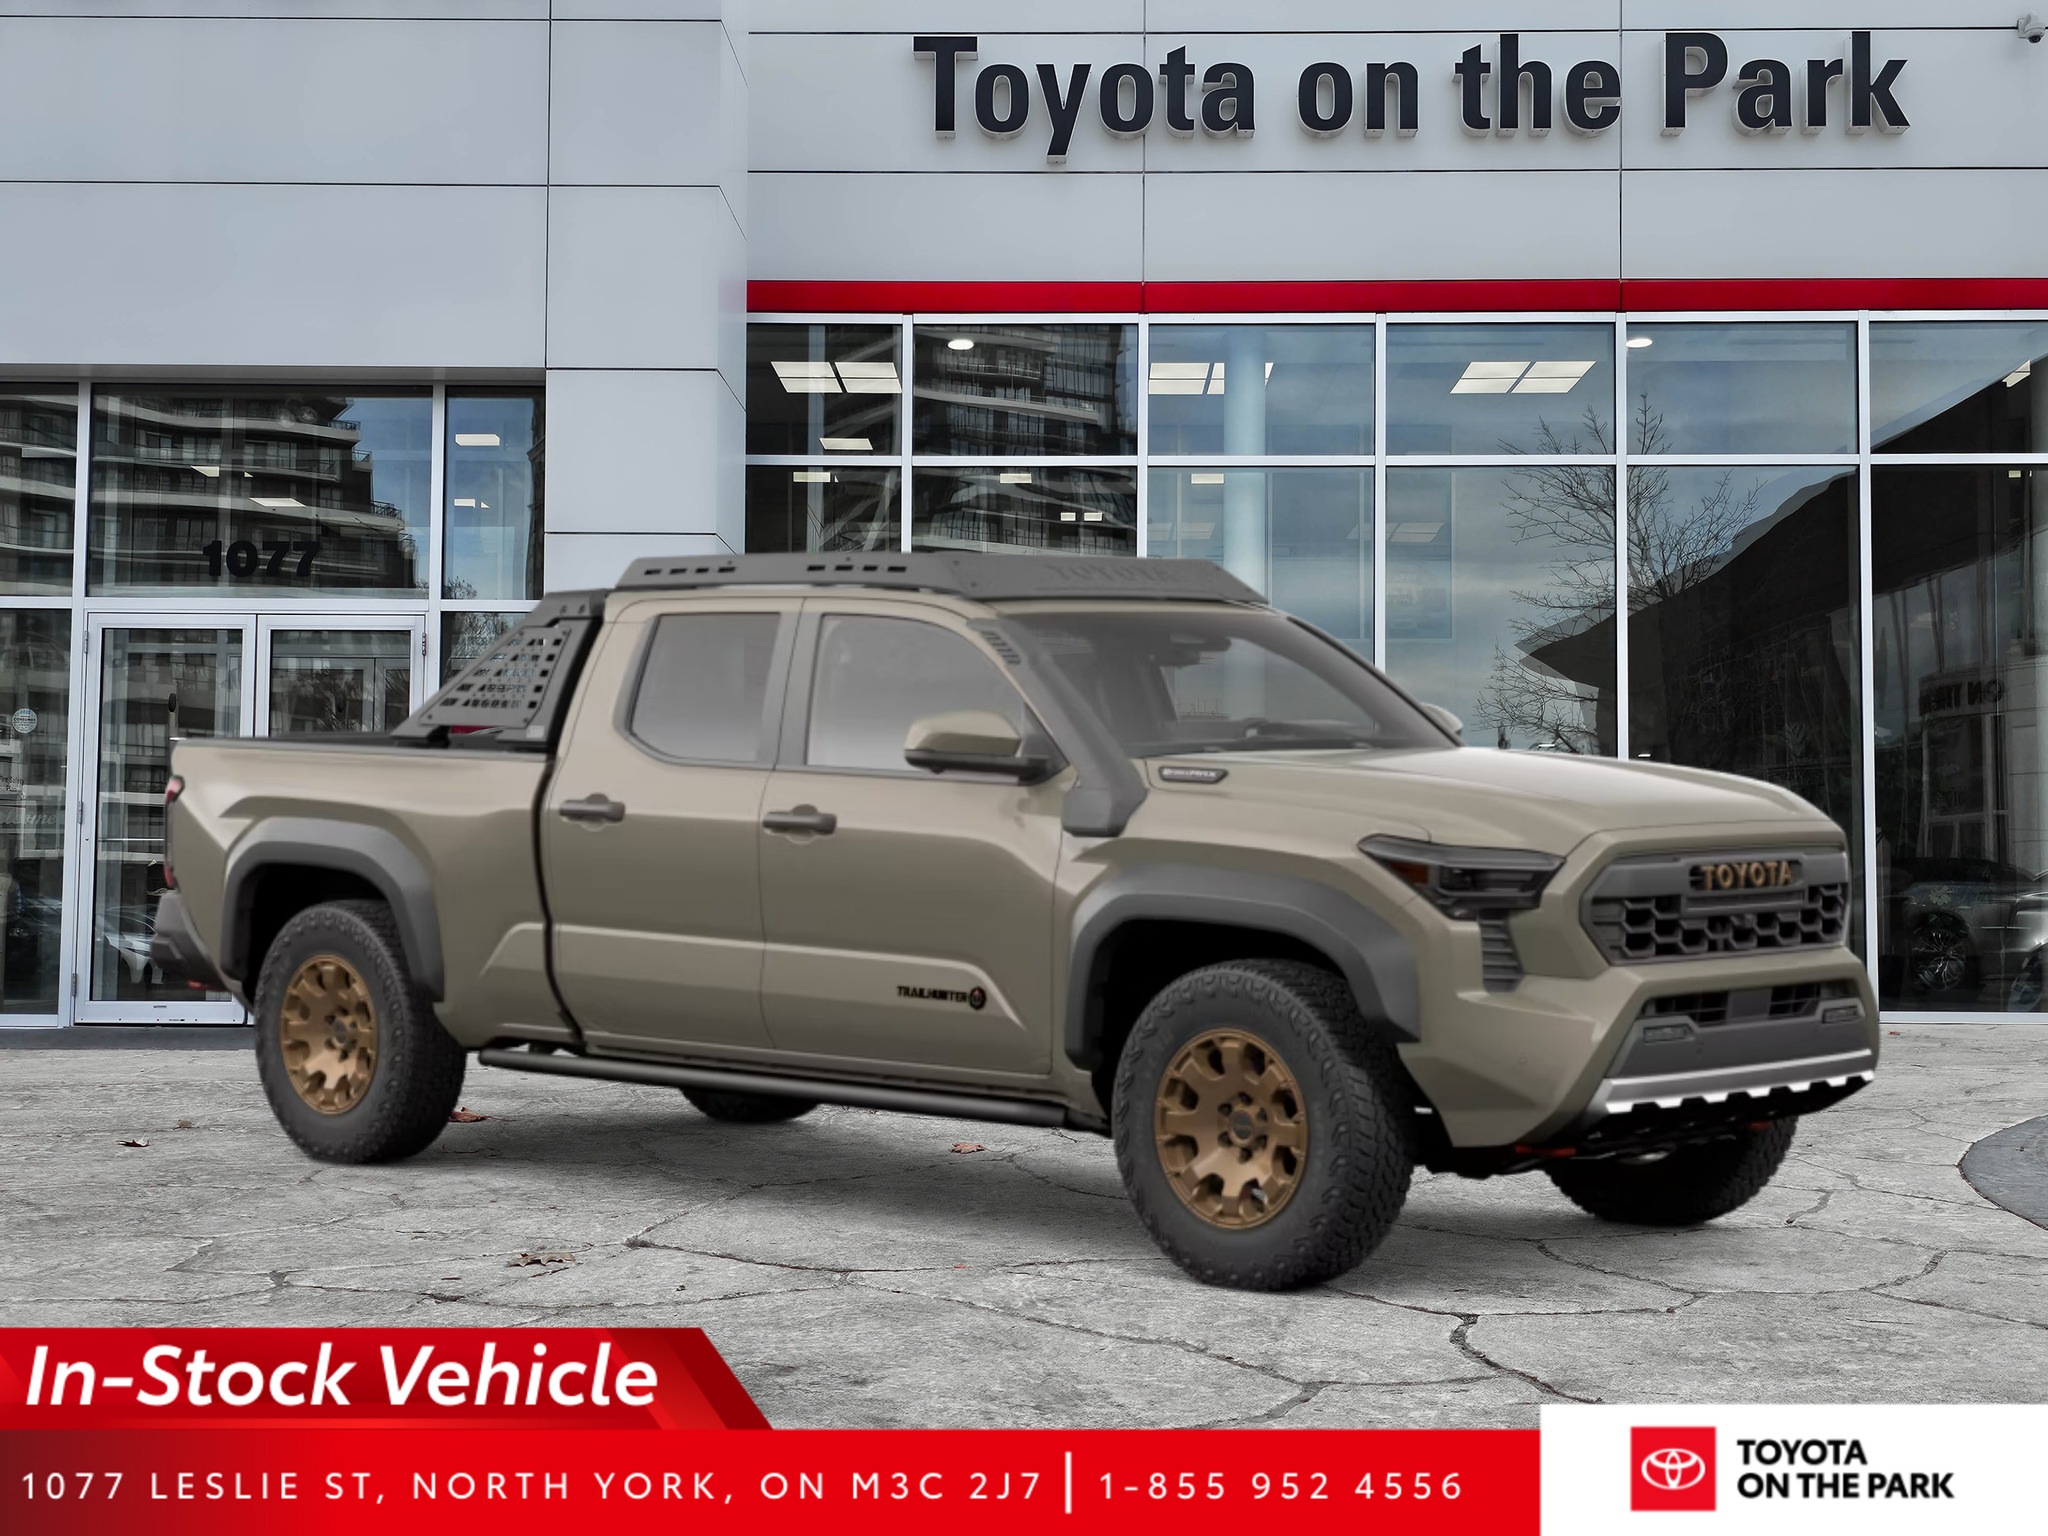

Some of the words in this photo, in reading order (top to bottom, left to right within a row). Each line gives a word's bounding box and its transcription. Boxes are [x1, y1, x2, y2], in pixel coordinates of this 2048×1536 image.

[912, 36, 1257, 160] Toyota
[1297, 62, 1419, 136] on
[1454, 34, 1621, 134] the
[1662, 31, 1911, 134] Park
[202, 540, 321, 577] 1077
[1703, 861, 1792, 891] TOYOTA
[897, 986, 967, 1002] TRAILHUNTER
